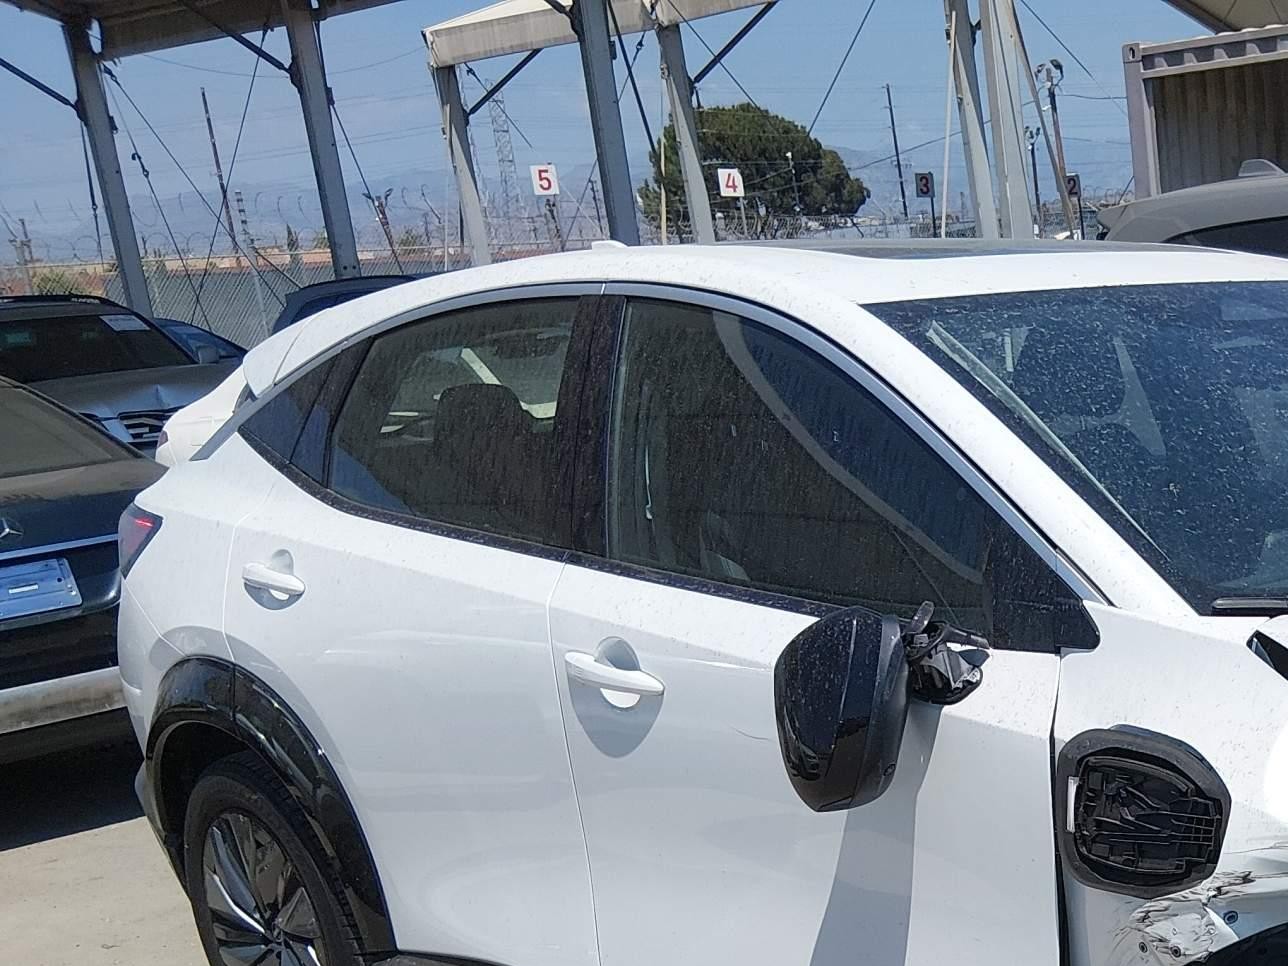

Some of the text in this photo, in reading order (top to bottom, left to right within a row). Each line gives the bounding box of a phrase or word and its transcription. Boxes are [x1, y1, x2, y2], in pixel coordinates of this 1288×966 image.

[538, 169, 552, 190] 5
[725, 173, 738, 192] 4
[919, 176, 930, 195] 3
[1067, 177, 1079, 195] 2
